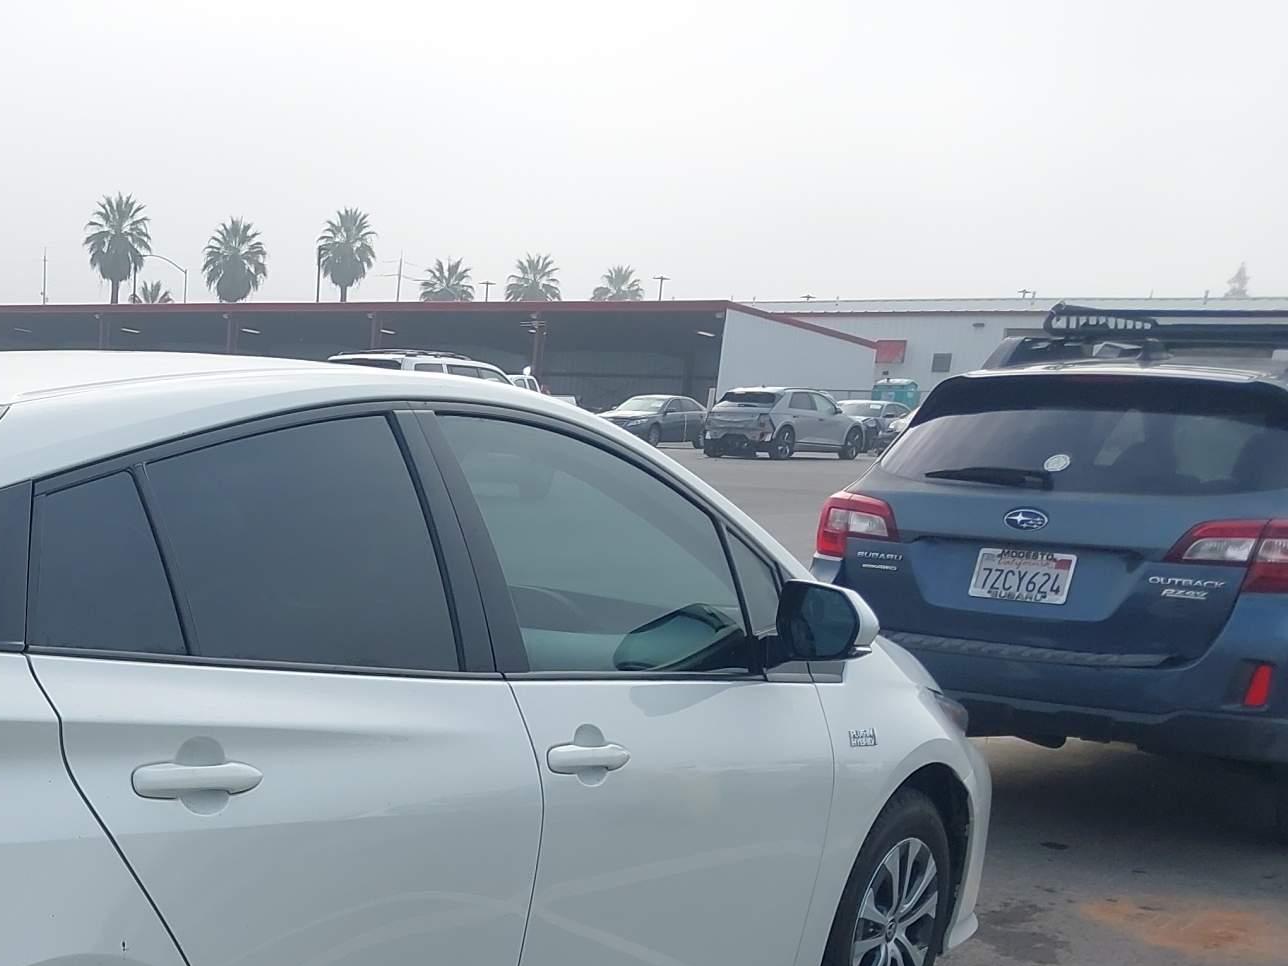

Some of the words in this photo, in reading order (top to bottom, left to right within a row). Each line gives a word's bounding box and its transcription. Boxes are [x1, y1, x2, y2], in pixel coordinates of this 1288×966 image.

[857, 551, 903, 561] SUBARU
[981, 568, 1061, 595] 7ZCY624
[1148, 576, 1225, 588] OUTBACK
